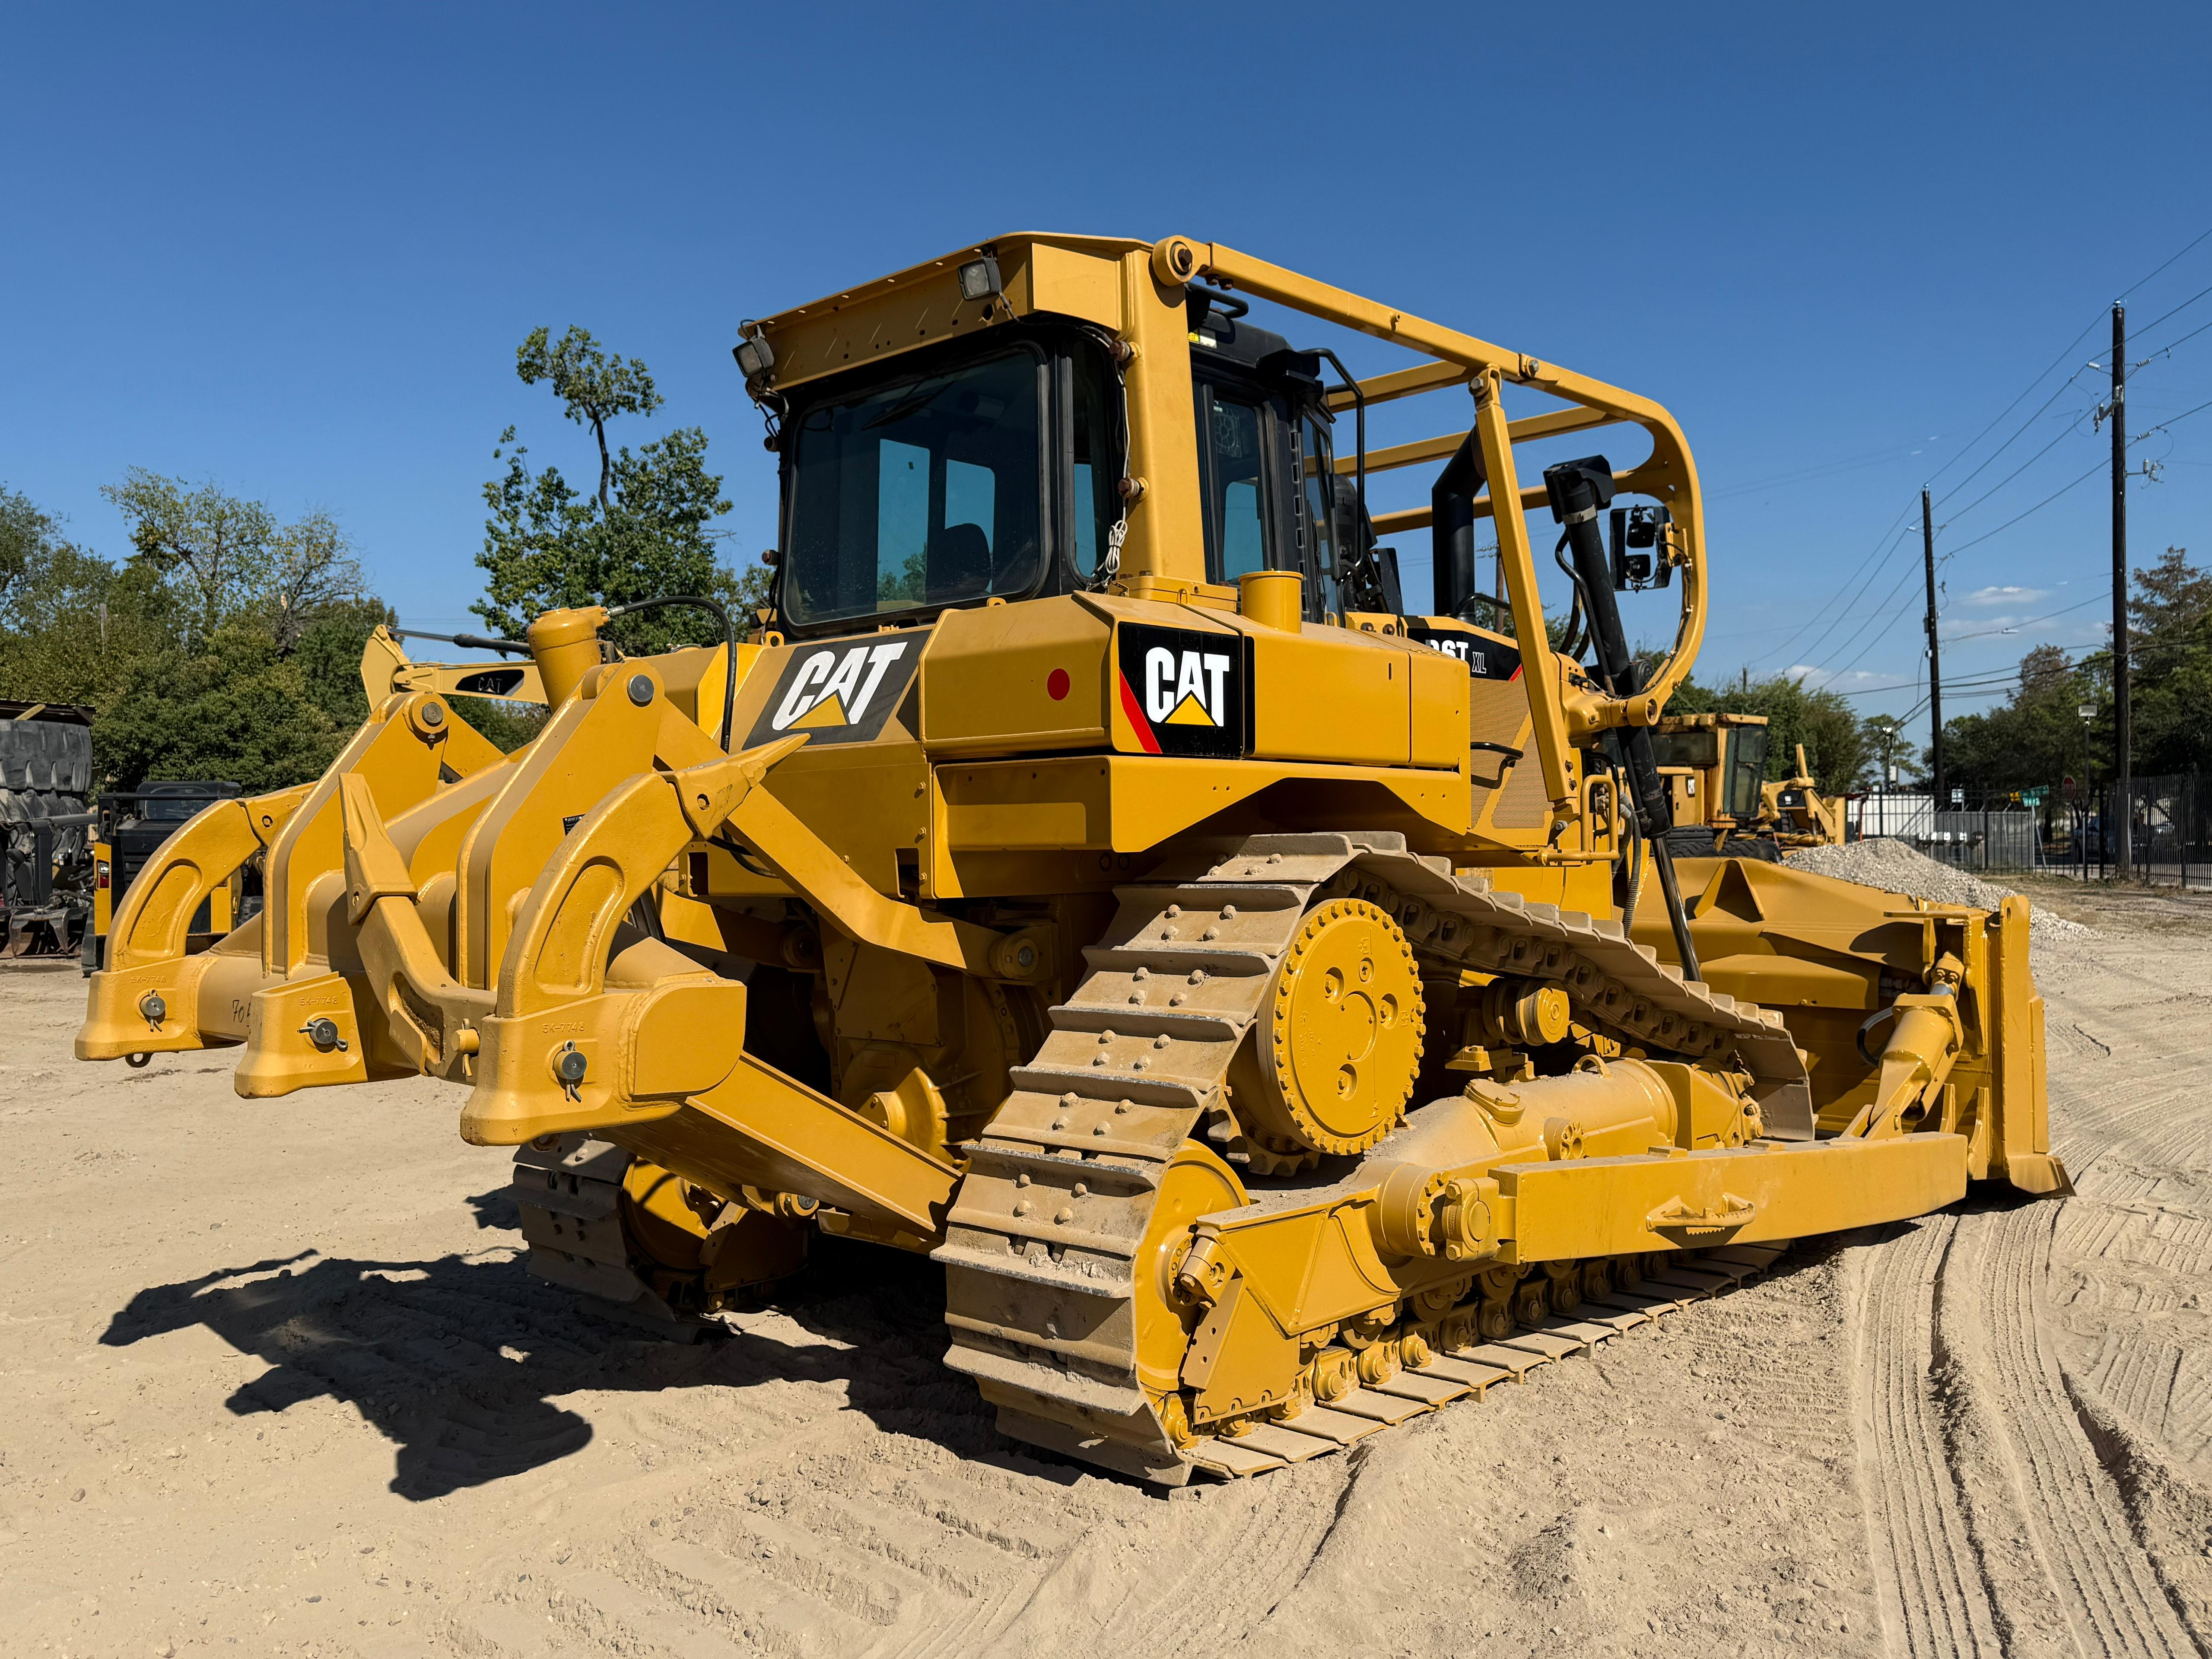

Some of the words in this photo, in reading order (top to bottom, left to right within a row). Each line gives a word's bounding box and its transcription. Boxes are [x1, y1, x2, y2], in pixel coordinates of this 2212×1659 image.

[1471, 652, 1487, 674] XL
[478, 677, 502, 693] CAT
[772, 642, 908, 730] CAT
[1146, 647, 1230, 727] CAT
[543, 1022, 585, 1033] 5K-7748
